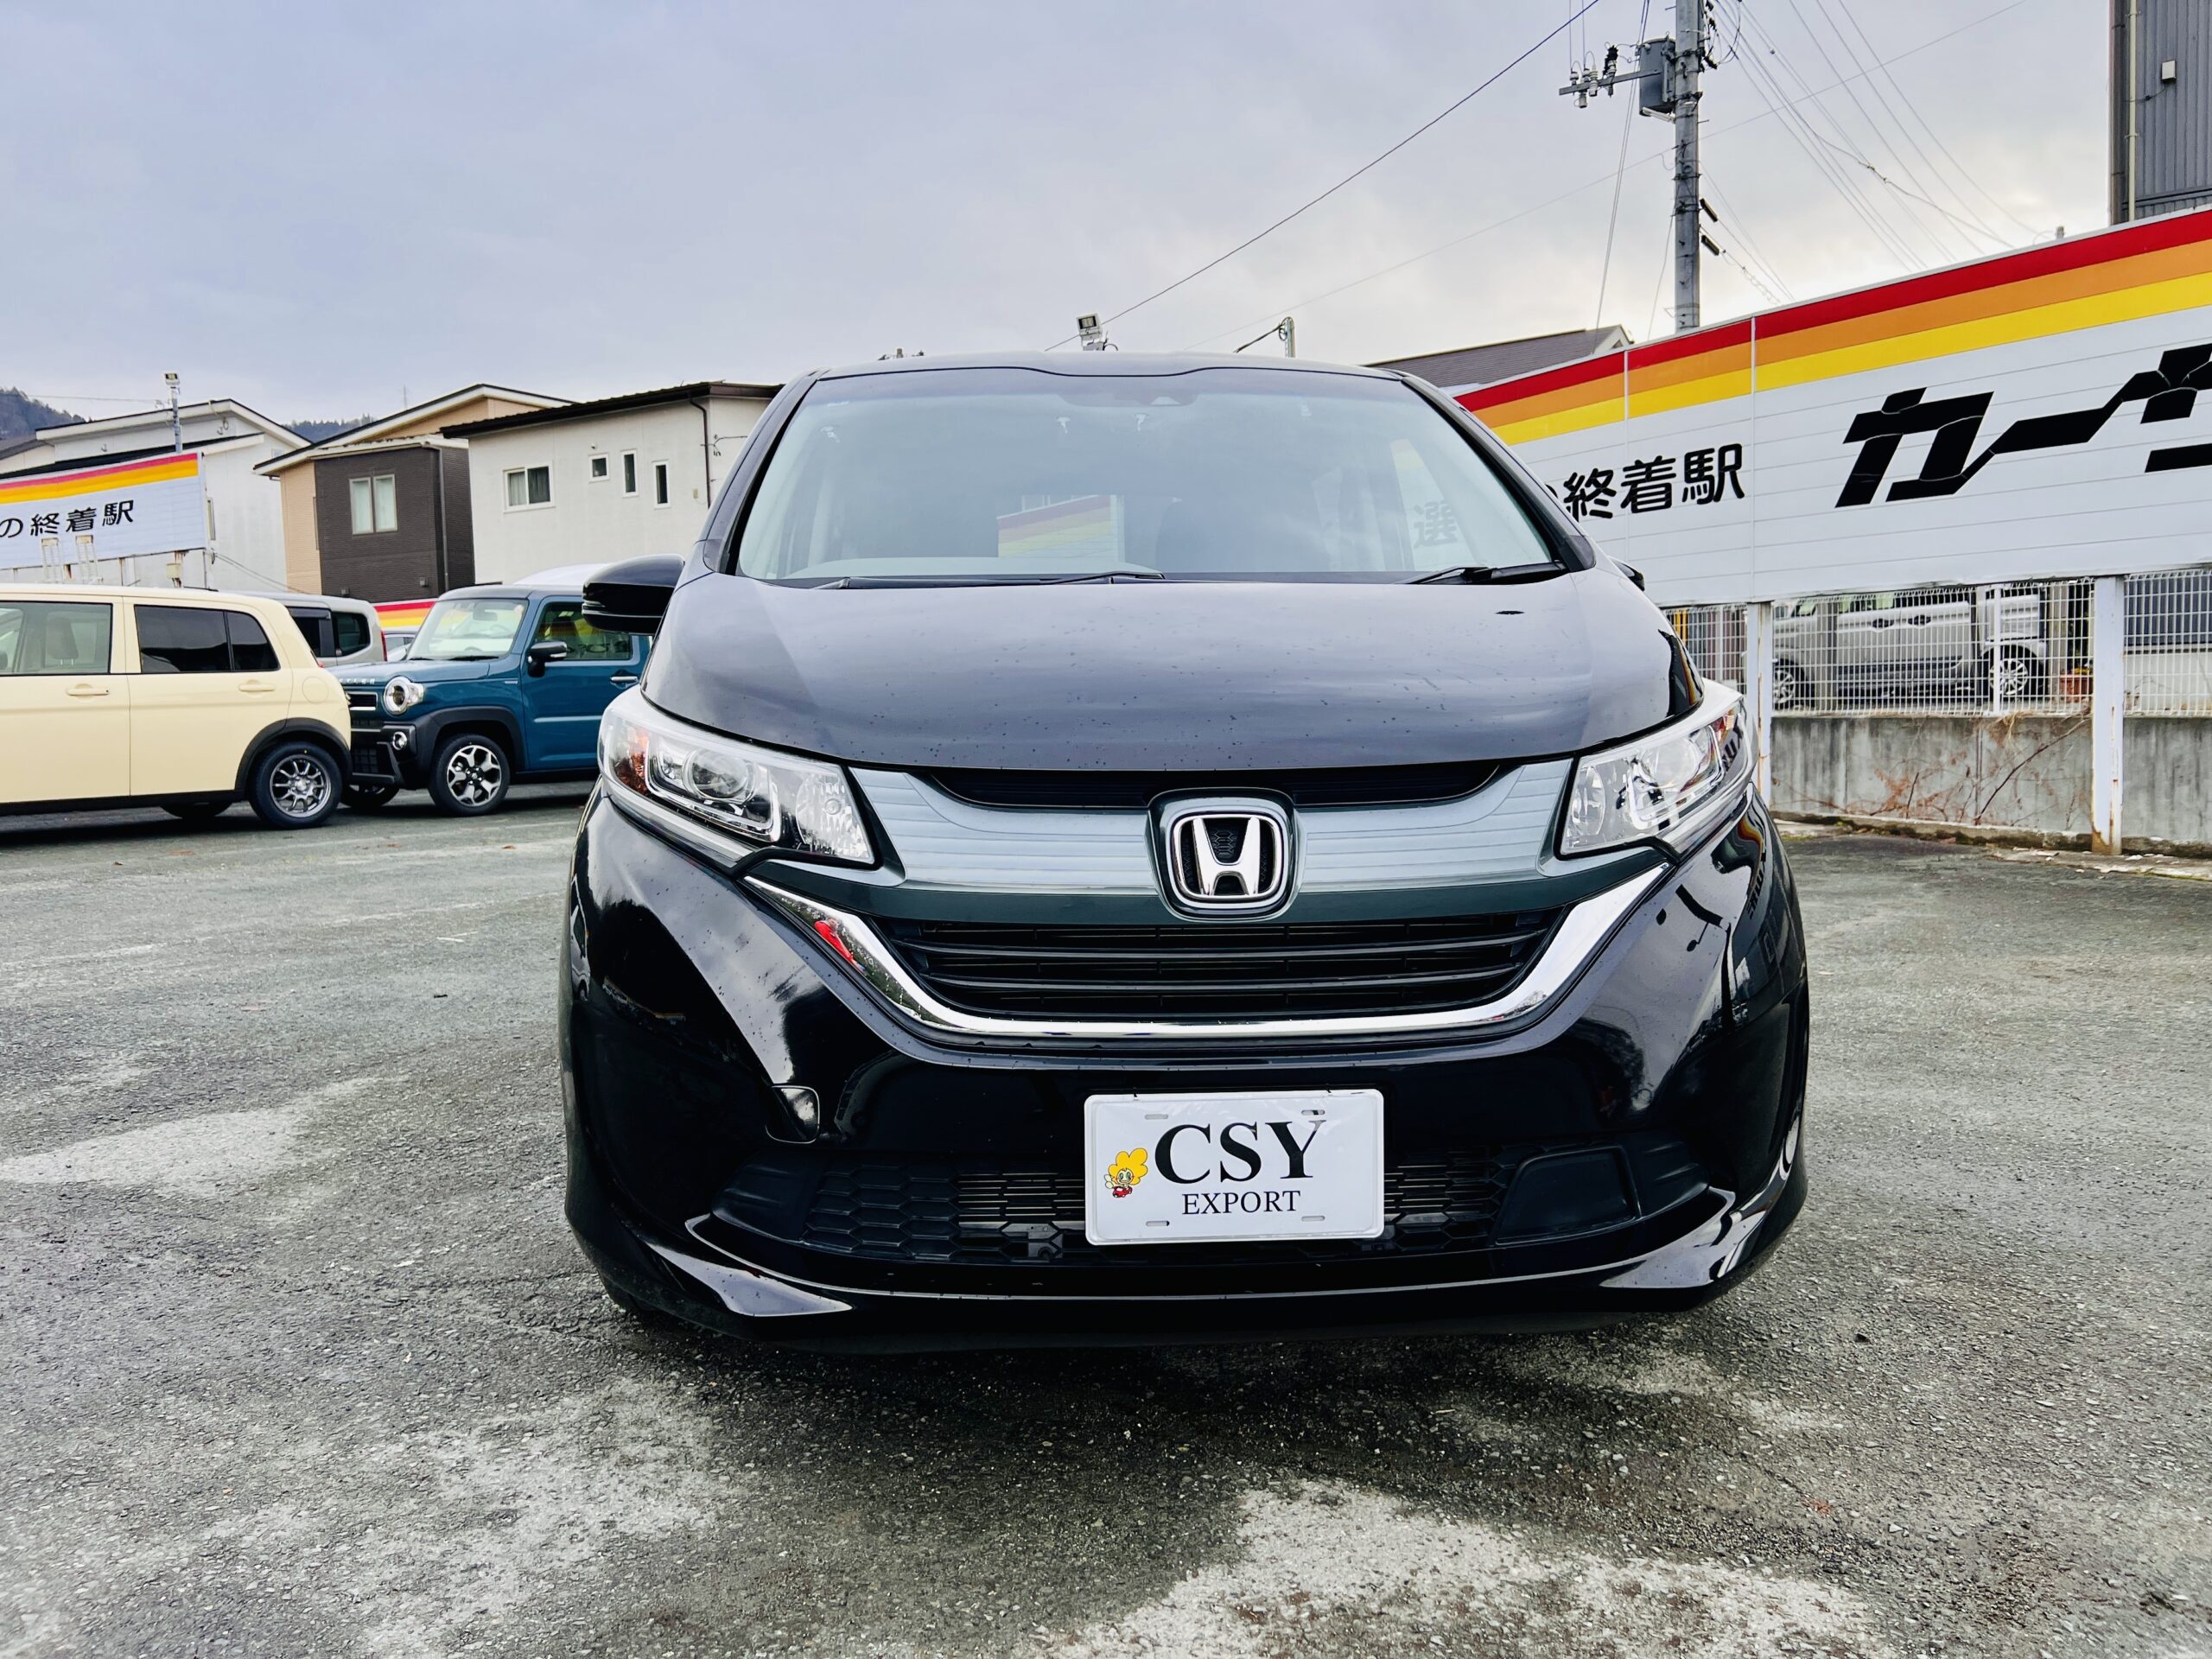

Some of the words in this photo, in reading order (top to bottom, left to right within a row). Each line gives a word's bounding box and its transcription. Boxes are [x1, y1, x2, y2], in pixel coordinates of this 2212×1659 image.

[1545, 442, 1745, 523] 終着駅
[0, 499, 134, 538] の終着駅
[1154, 1119, 1326, 1184] CSY
[1181, 1190, 1300, 1215] EXPORT
